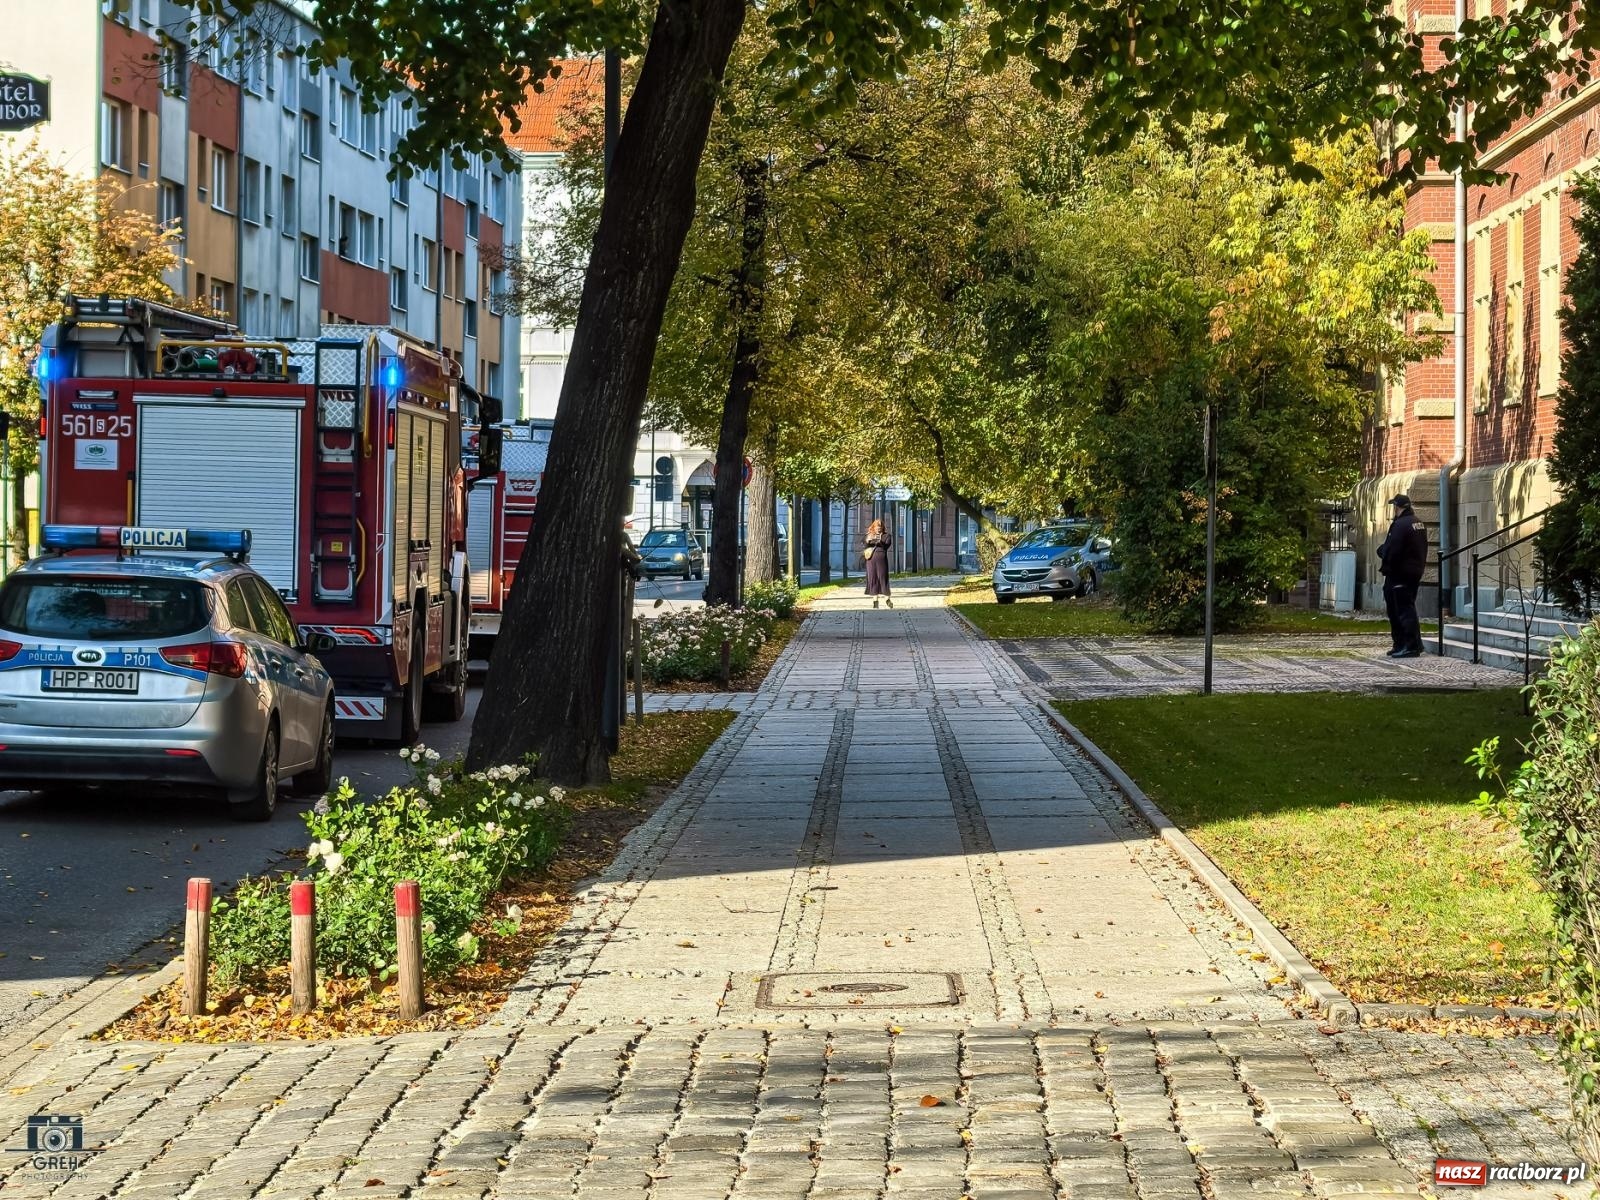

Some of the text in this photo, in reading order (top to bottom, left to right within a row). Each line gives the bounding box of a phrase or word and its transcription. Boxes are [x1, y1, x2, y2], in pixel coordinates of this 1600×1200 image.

[0, 83, 36, 102] tel
[122, 530, 185, 547] POLICJA
[28, 652, 64, 662] POLICJA
[124, 653, 151, 667] P101
[52, 671, 134, 689] HPP R001
